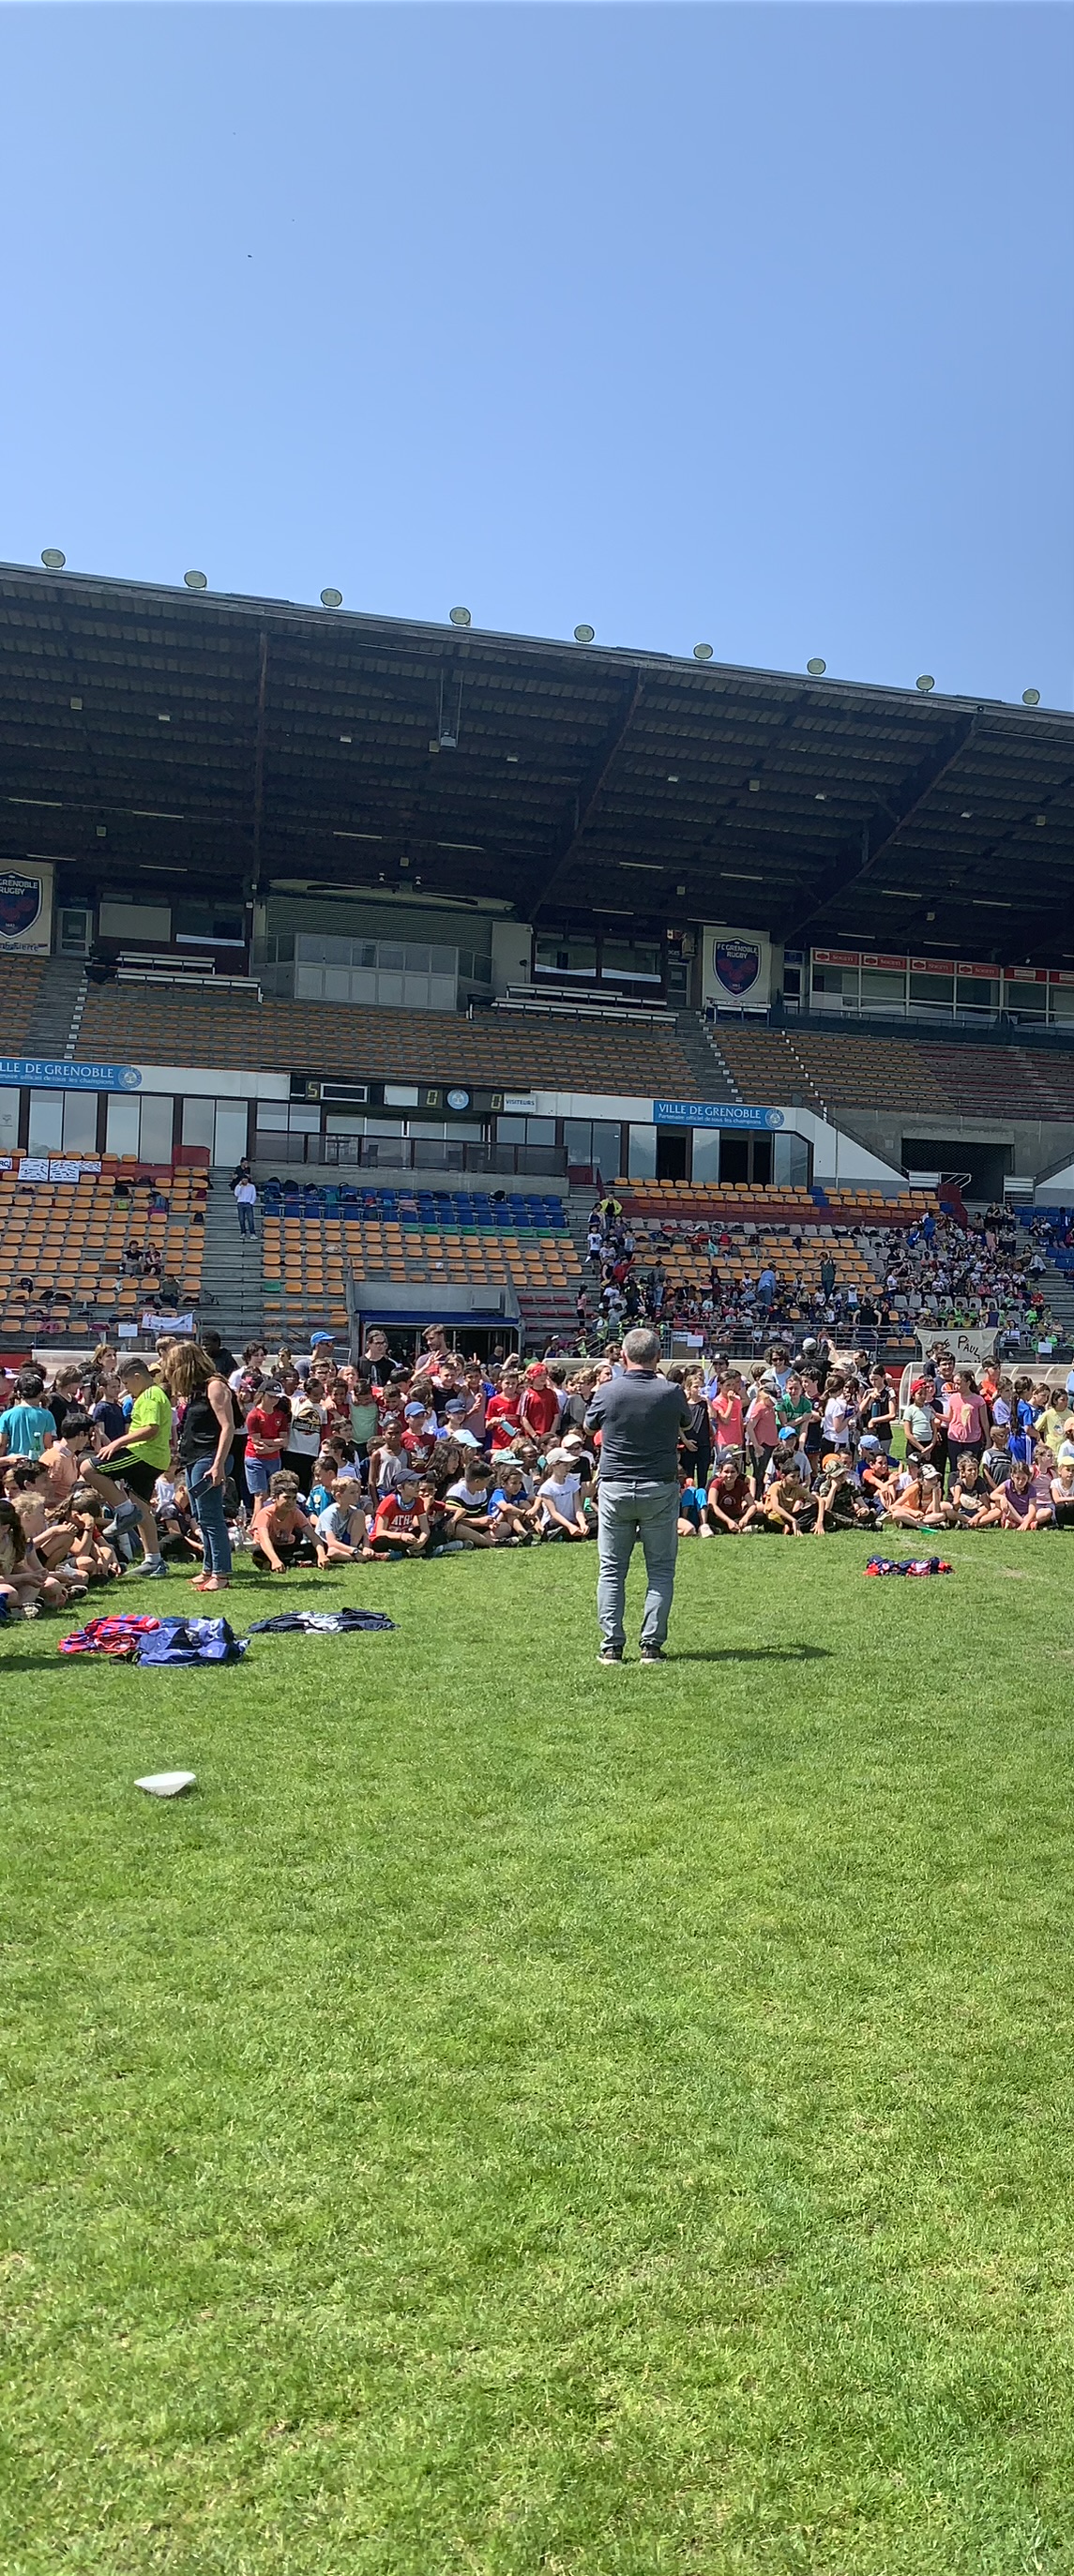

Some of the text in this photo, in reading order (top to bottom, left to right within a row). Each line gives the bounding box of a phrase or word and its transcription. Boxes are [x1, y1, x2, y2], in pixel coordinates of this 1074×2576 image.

[726, 944, 758, 954] GRENOBLE
[726, 951, 749, 959] RUGBY
[25, 1063, 42, 1074] DE
[44, 1064, 114, 1078] GRENOBLE
[79, 1077, 114, 1086] champions
[426, 1090, 438, 1106] 0
[491, 1094, 502, 1109] 0
[658, 1104, 687, 1115] VILLE
[689, 1106, 703, 1115] DE
[704, 1107, 762, 1119] GRENOBLE
[957, 1334, 980, 1357] PAUL
[390, 1514, 413, 1526] ATH
